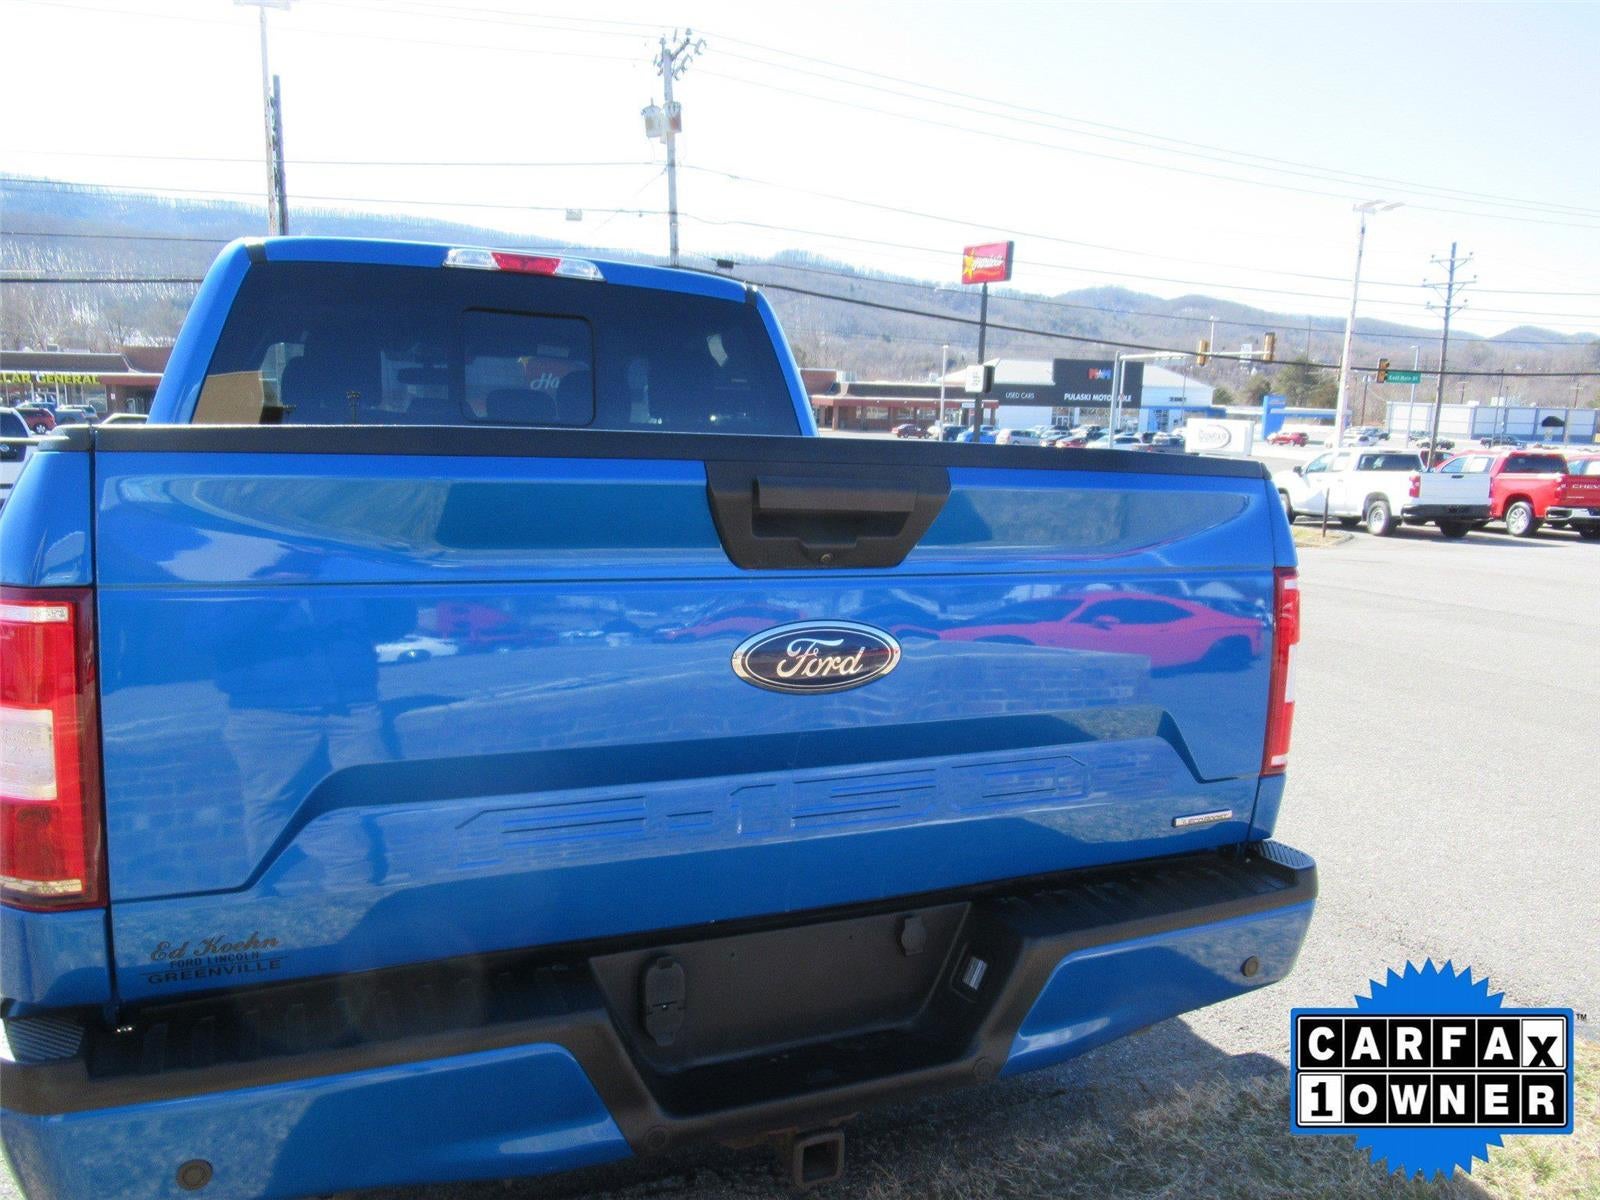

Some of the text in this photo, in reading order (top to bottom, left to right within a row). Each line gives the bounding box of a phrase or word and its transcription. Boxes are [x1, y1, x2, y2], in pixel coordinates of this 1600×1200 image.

[0, 373, 100, 385] LAR GENERAL
[1064, 393, 1091, 401] PULASKI
[1092, 393, 1113, 401] MOTO
[776, 637, 866, 678] Ford
[150, 930, 280, 961] Ed Koehn
[170, 951, 260, 969] FORD LINCOLN
[148, 959, 281, 984] GREENVILLE
